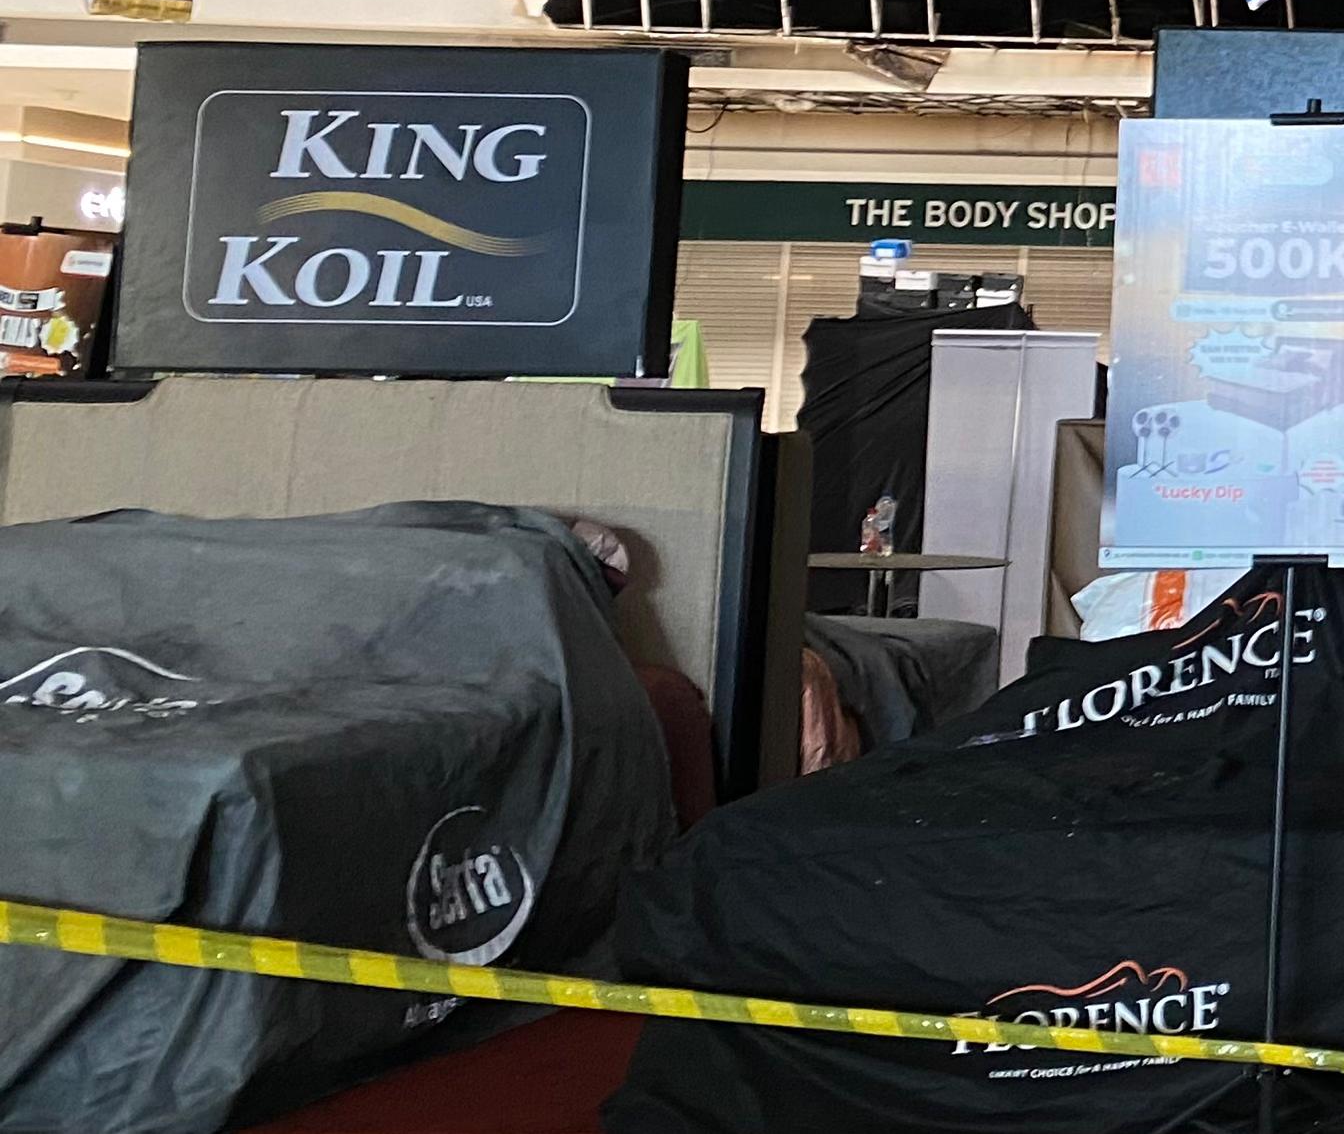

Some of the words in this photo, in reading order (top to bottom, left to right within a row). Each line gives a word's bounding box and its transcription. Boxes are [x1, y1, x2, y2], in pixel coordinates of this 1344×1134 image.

[270, 109, 547, 182] KING
[846, 198, 912, 227] THE
[924, 200, 1020, 229] BODY
[1026, 202, 1116, 230] SHOP
[208, 235, 464, 307] KOIL
[1214, 485, 1244, 502] Dip
[1226, 693, 1278, 707] FAMILY
[1030, 1067, 1073, 1079] CHOICE
